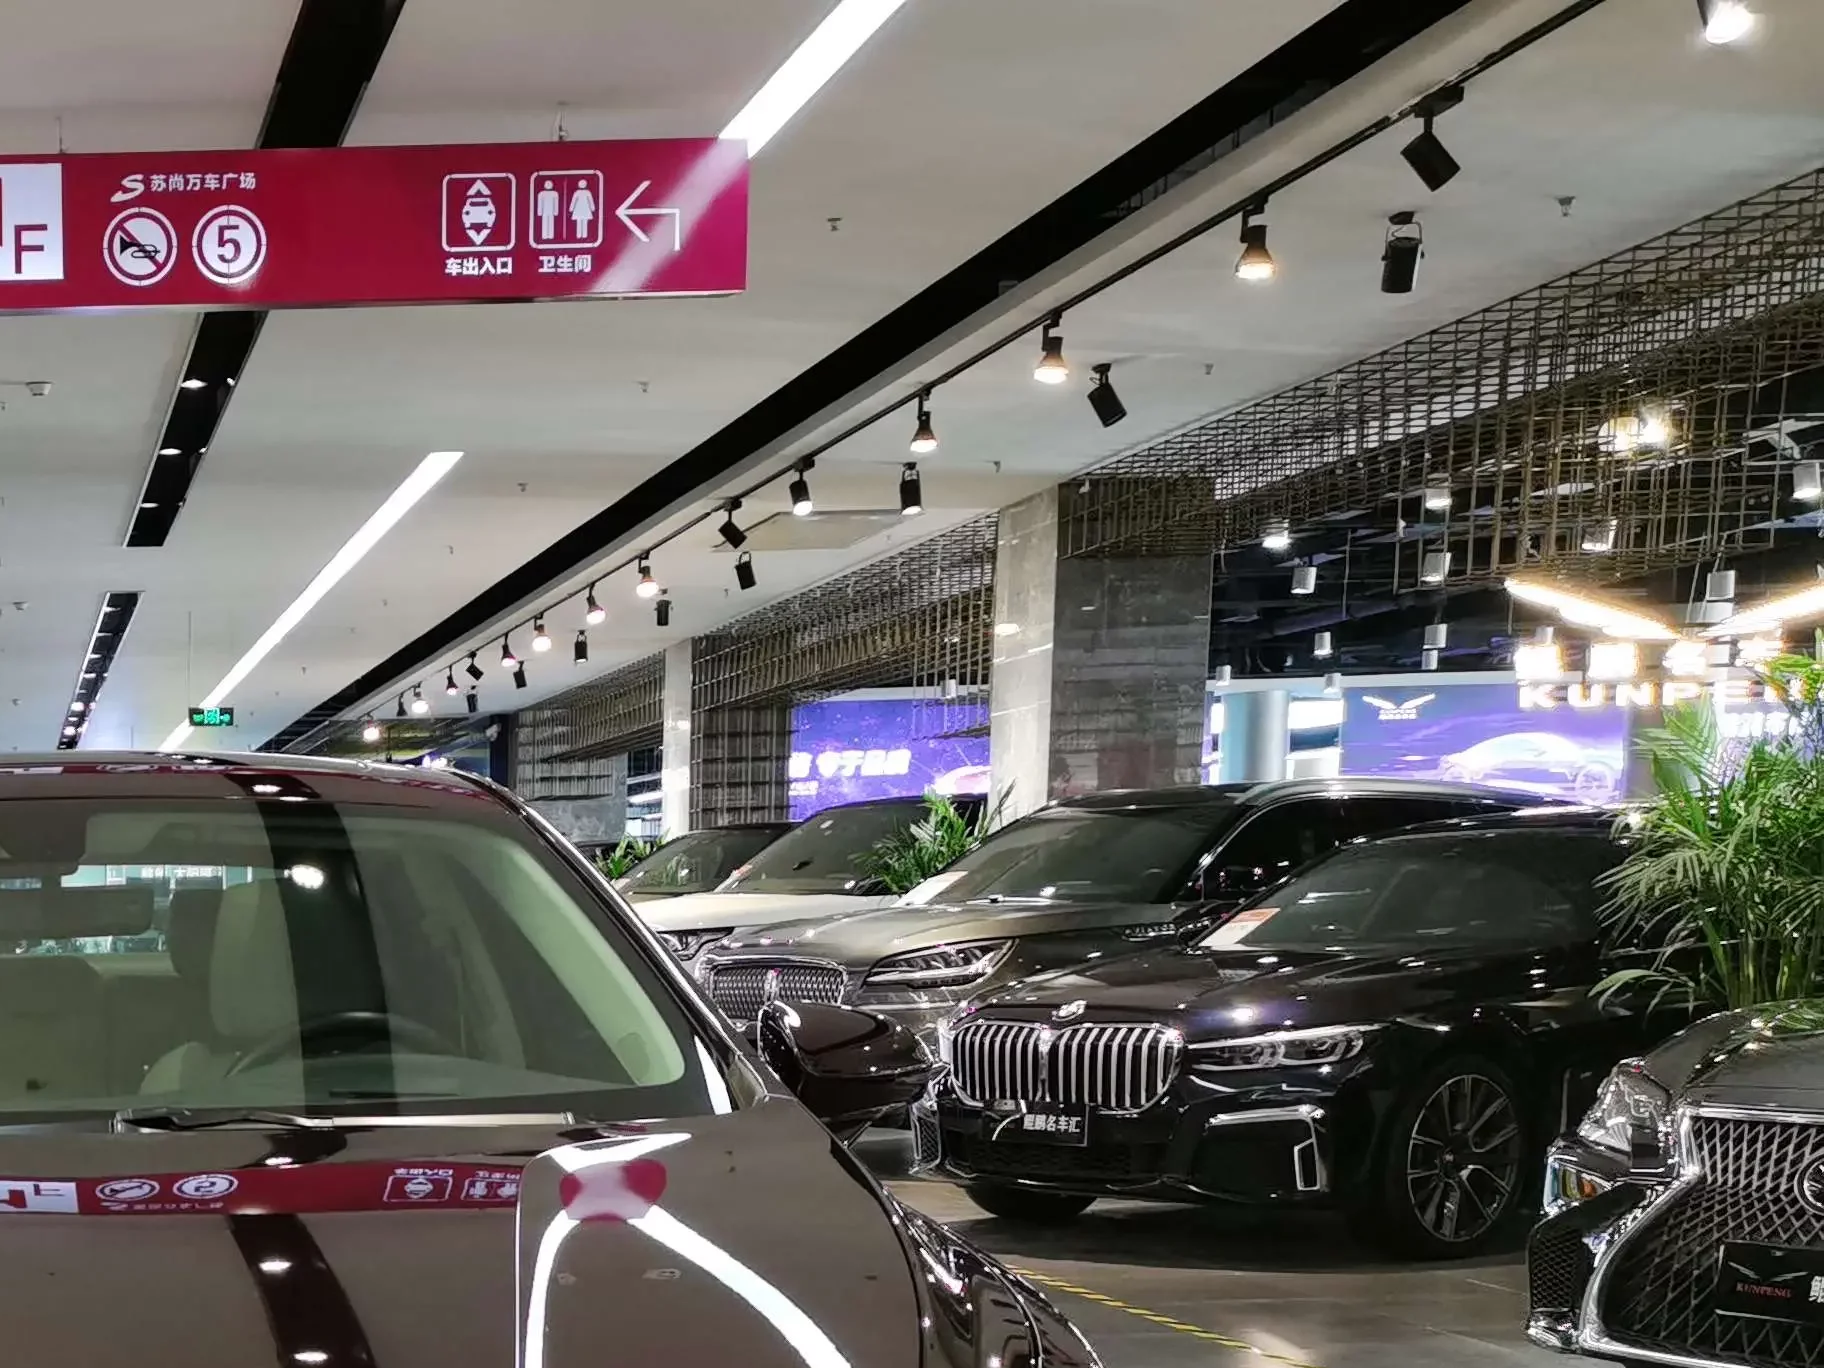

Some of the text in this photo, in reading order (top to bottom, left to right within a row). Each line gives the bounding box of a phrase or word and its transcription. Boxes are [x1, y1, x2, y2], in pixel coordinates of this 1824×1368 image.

[149, 172, 257, 192] 苏尚万车广场
[216, 224, 242, 264] 5
[445, 256, 513, 276] 车出入口
[538, 254, 592, 273] 卫生间
